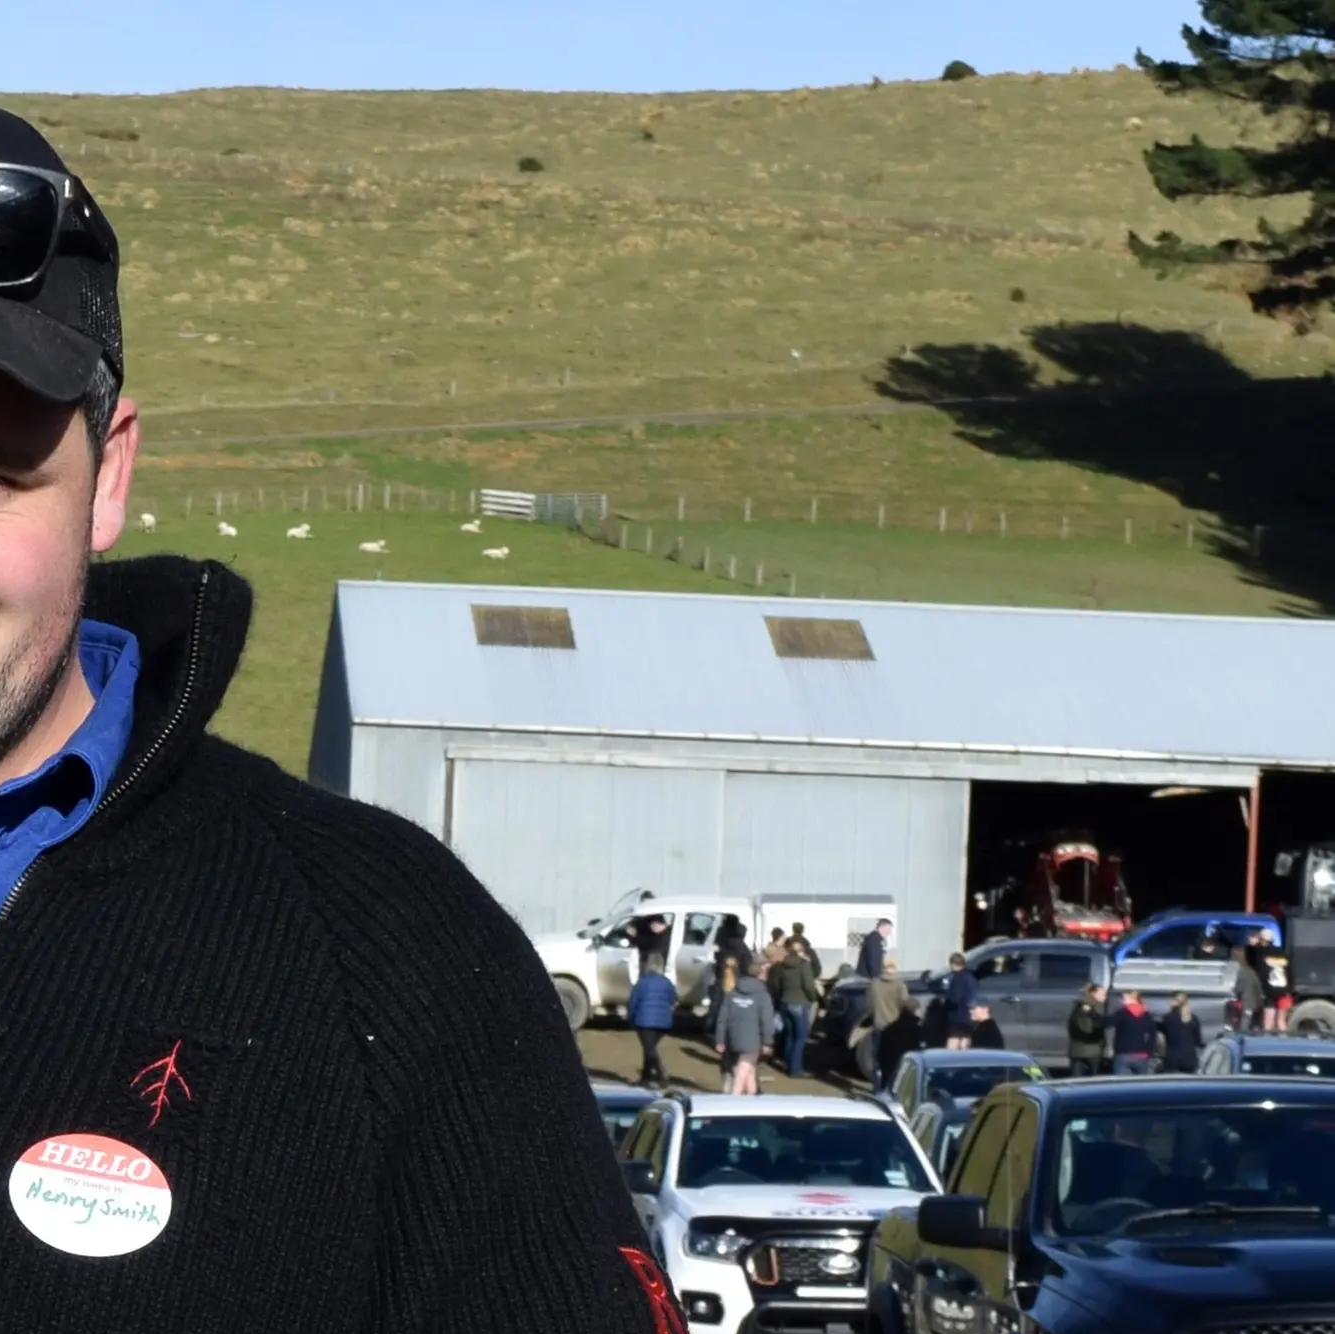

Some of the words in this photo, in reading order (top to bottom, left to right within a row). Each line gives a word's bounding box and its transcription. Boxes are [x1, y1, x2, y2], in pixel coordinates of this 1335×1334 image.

[37, 1140, 152, 1181] HELLO
[26, 1177, 98, 1225] Henry
[100, 1198, 160, 1226] Smith
